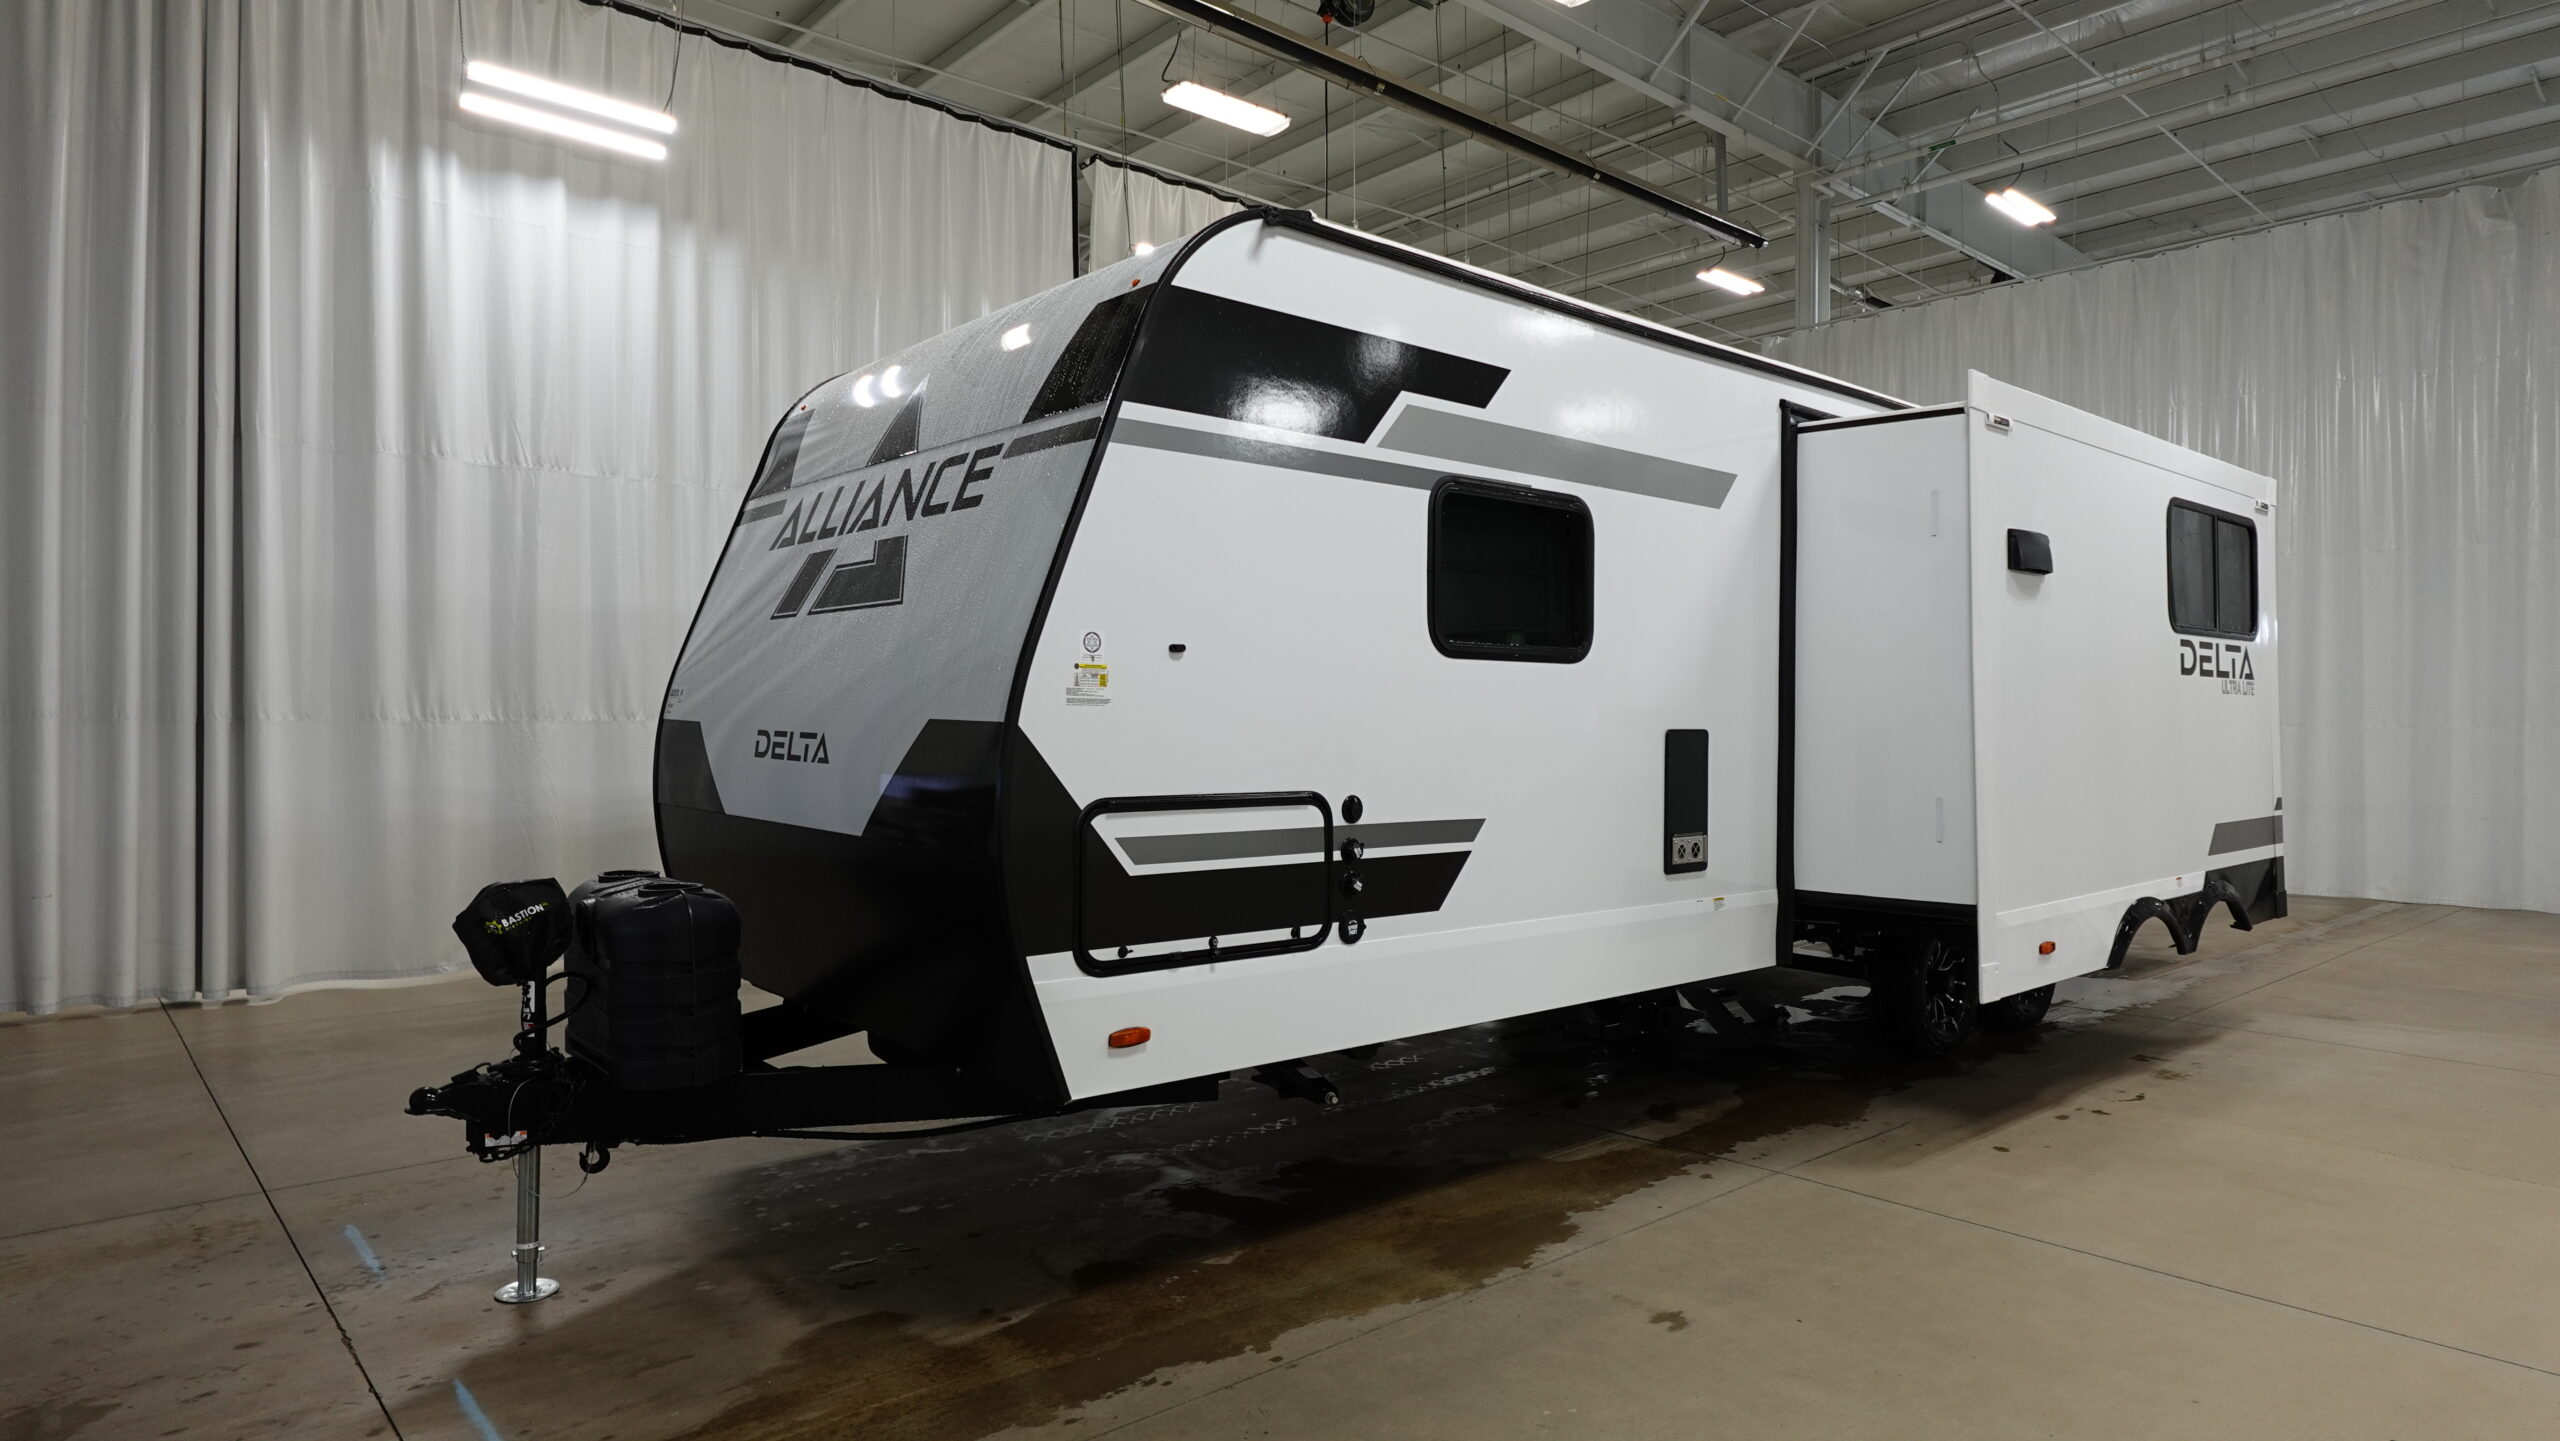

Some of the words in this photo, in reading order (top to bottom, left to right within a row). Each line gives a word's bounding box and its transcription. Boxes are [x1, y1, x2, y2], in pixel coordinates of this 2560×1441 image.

[768, 443, 1005, 551] ALLIANCE
[2180, 639, 2255, 680] DELTA
[2221, 680, 2242, 695] ULTRA
[2242, 680, 2255, 696] LITE
[754, 729, 830, 765] DELTA
[501, 904, 545, 928] BASTION
